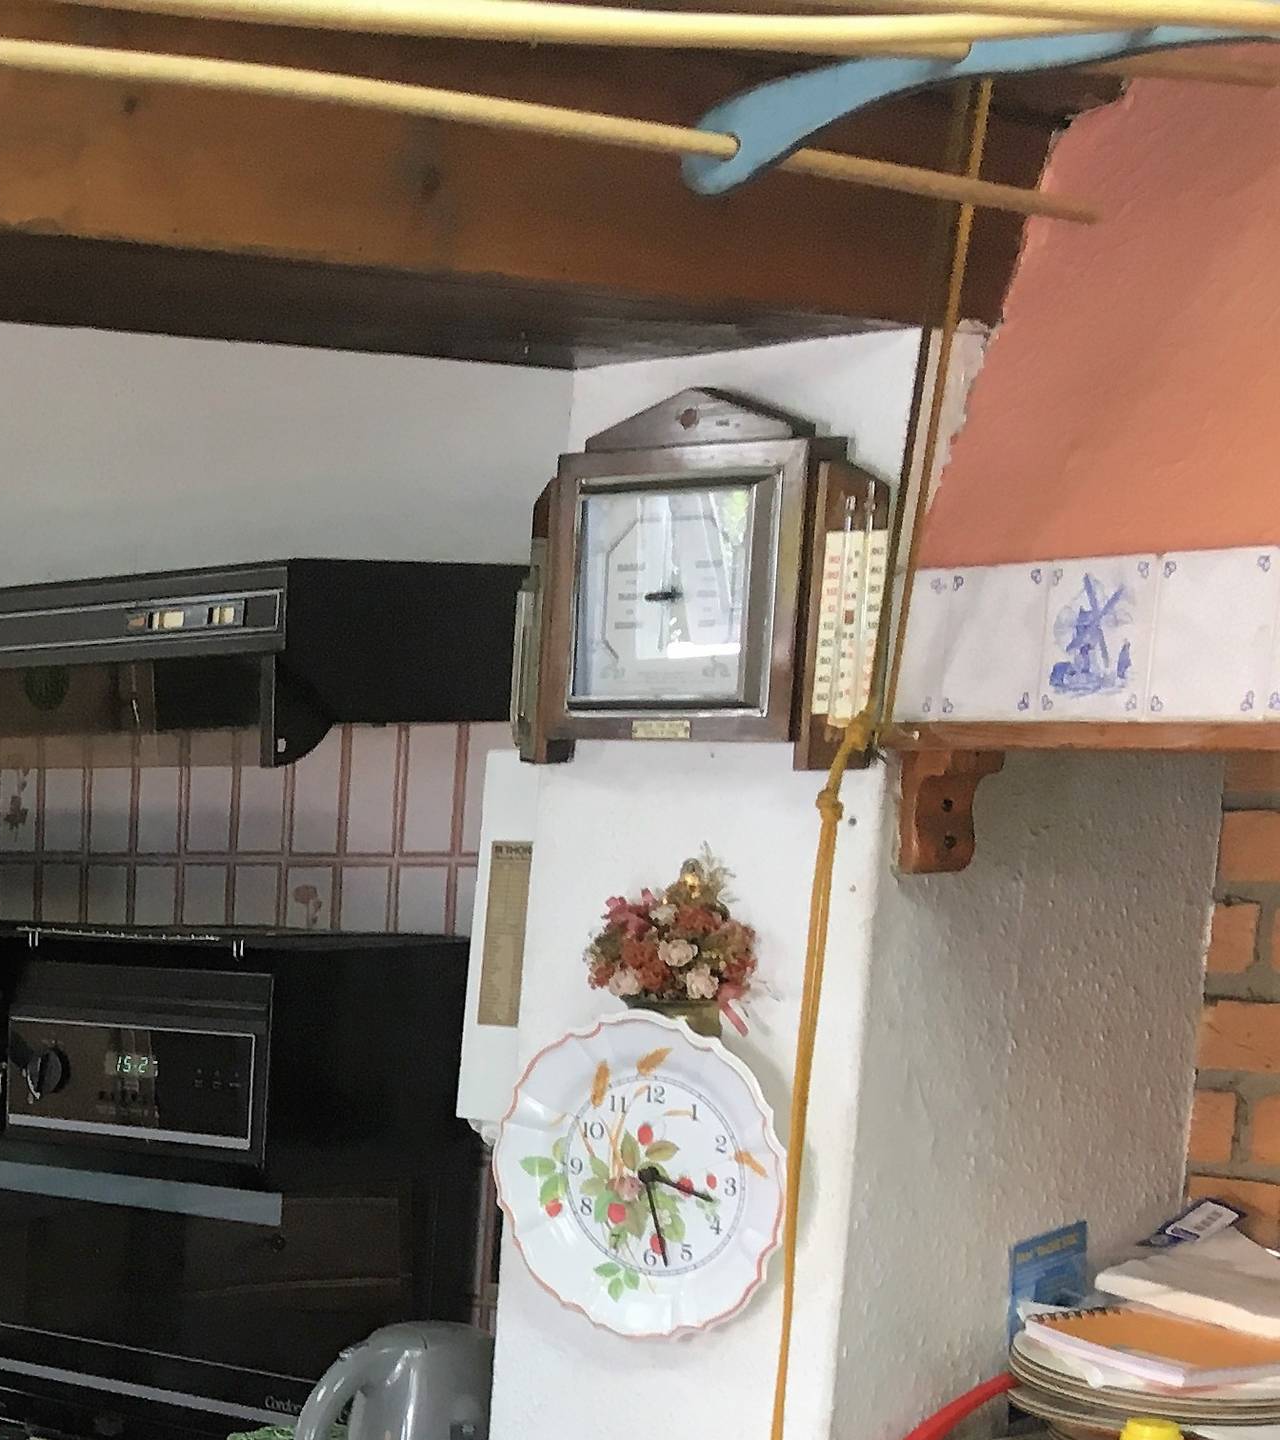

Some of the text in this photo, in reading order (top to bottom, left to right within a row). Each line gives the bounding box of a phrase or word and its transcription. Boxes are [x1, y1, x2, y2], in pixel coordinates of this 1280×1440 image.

[610, 1094, 627, 1114] 11
[646, 1084, 666, 1105] 12
[691, 1103, 699, 1122] 1
[583, 1121, 605, 1140] 10
[715, 1134, 728, 1154] 2
[570, 1157, 583, 1176] 9
[724, 1176, 738, 1197] 3
[580, 1197, 593, 1216] 8
[643, 1248, 657, 1267] 6
[680, 1244, 693, 1262] 5
